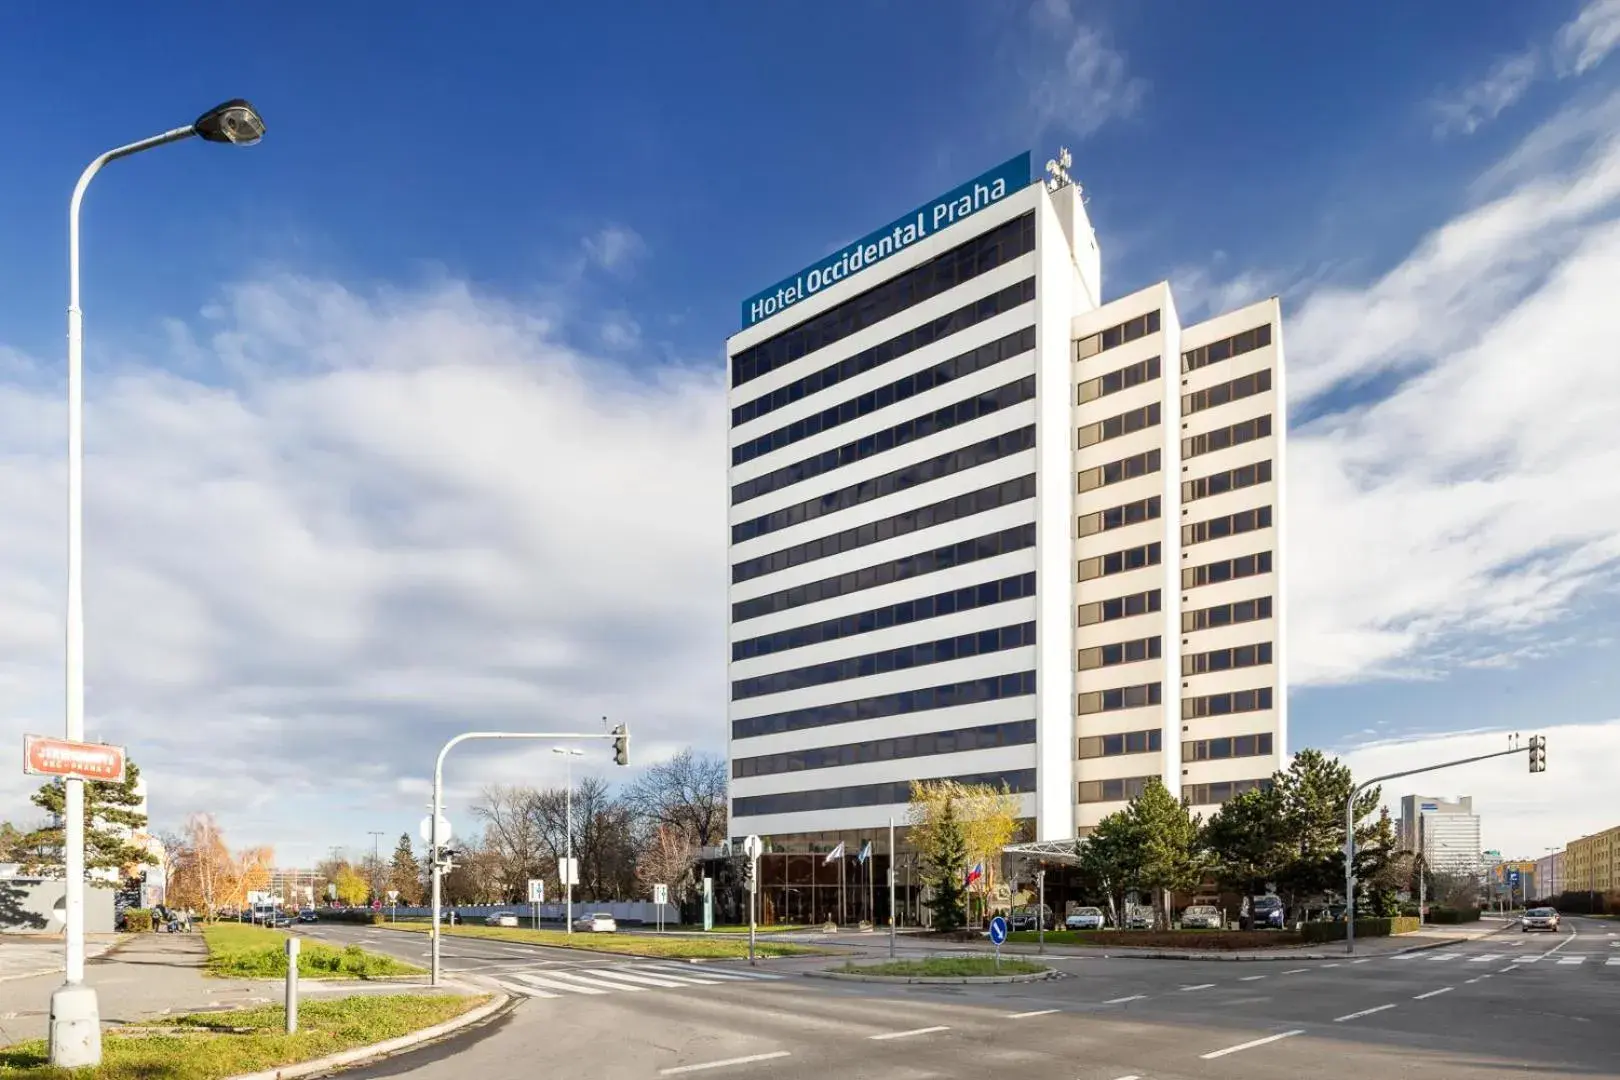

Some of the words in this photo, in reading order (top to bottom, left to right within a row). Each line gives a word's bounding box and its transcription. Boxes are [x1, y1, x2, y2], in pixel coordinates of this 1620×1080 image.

[751, 277, 804, 323] Hotel
[807, 213, 926, 294] Occidental
[933, 177, 1006, 230] Praha
